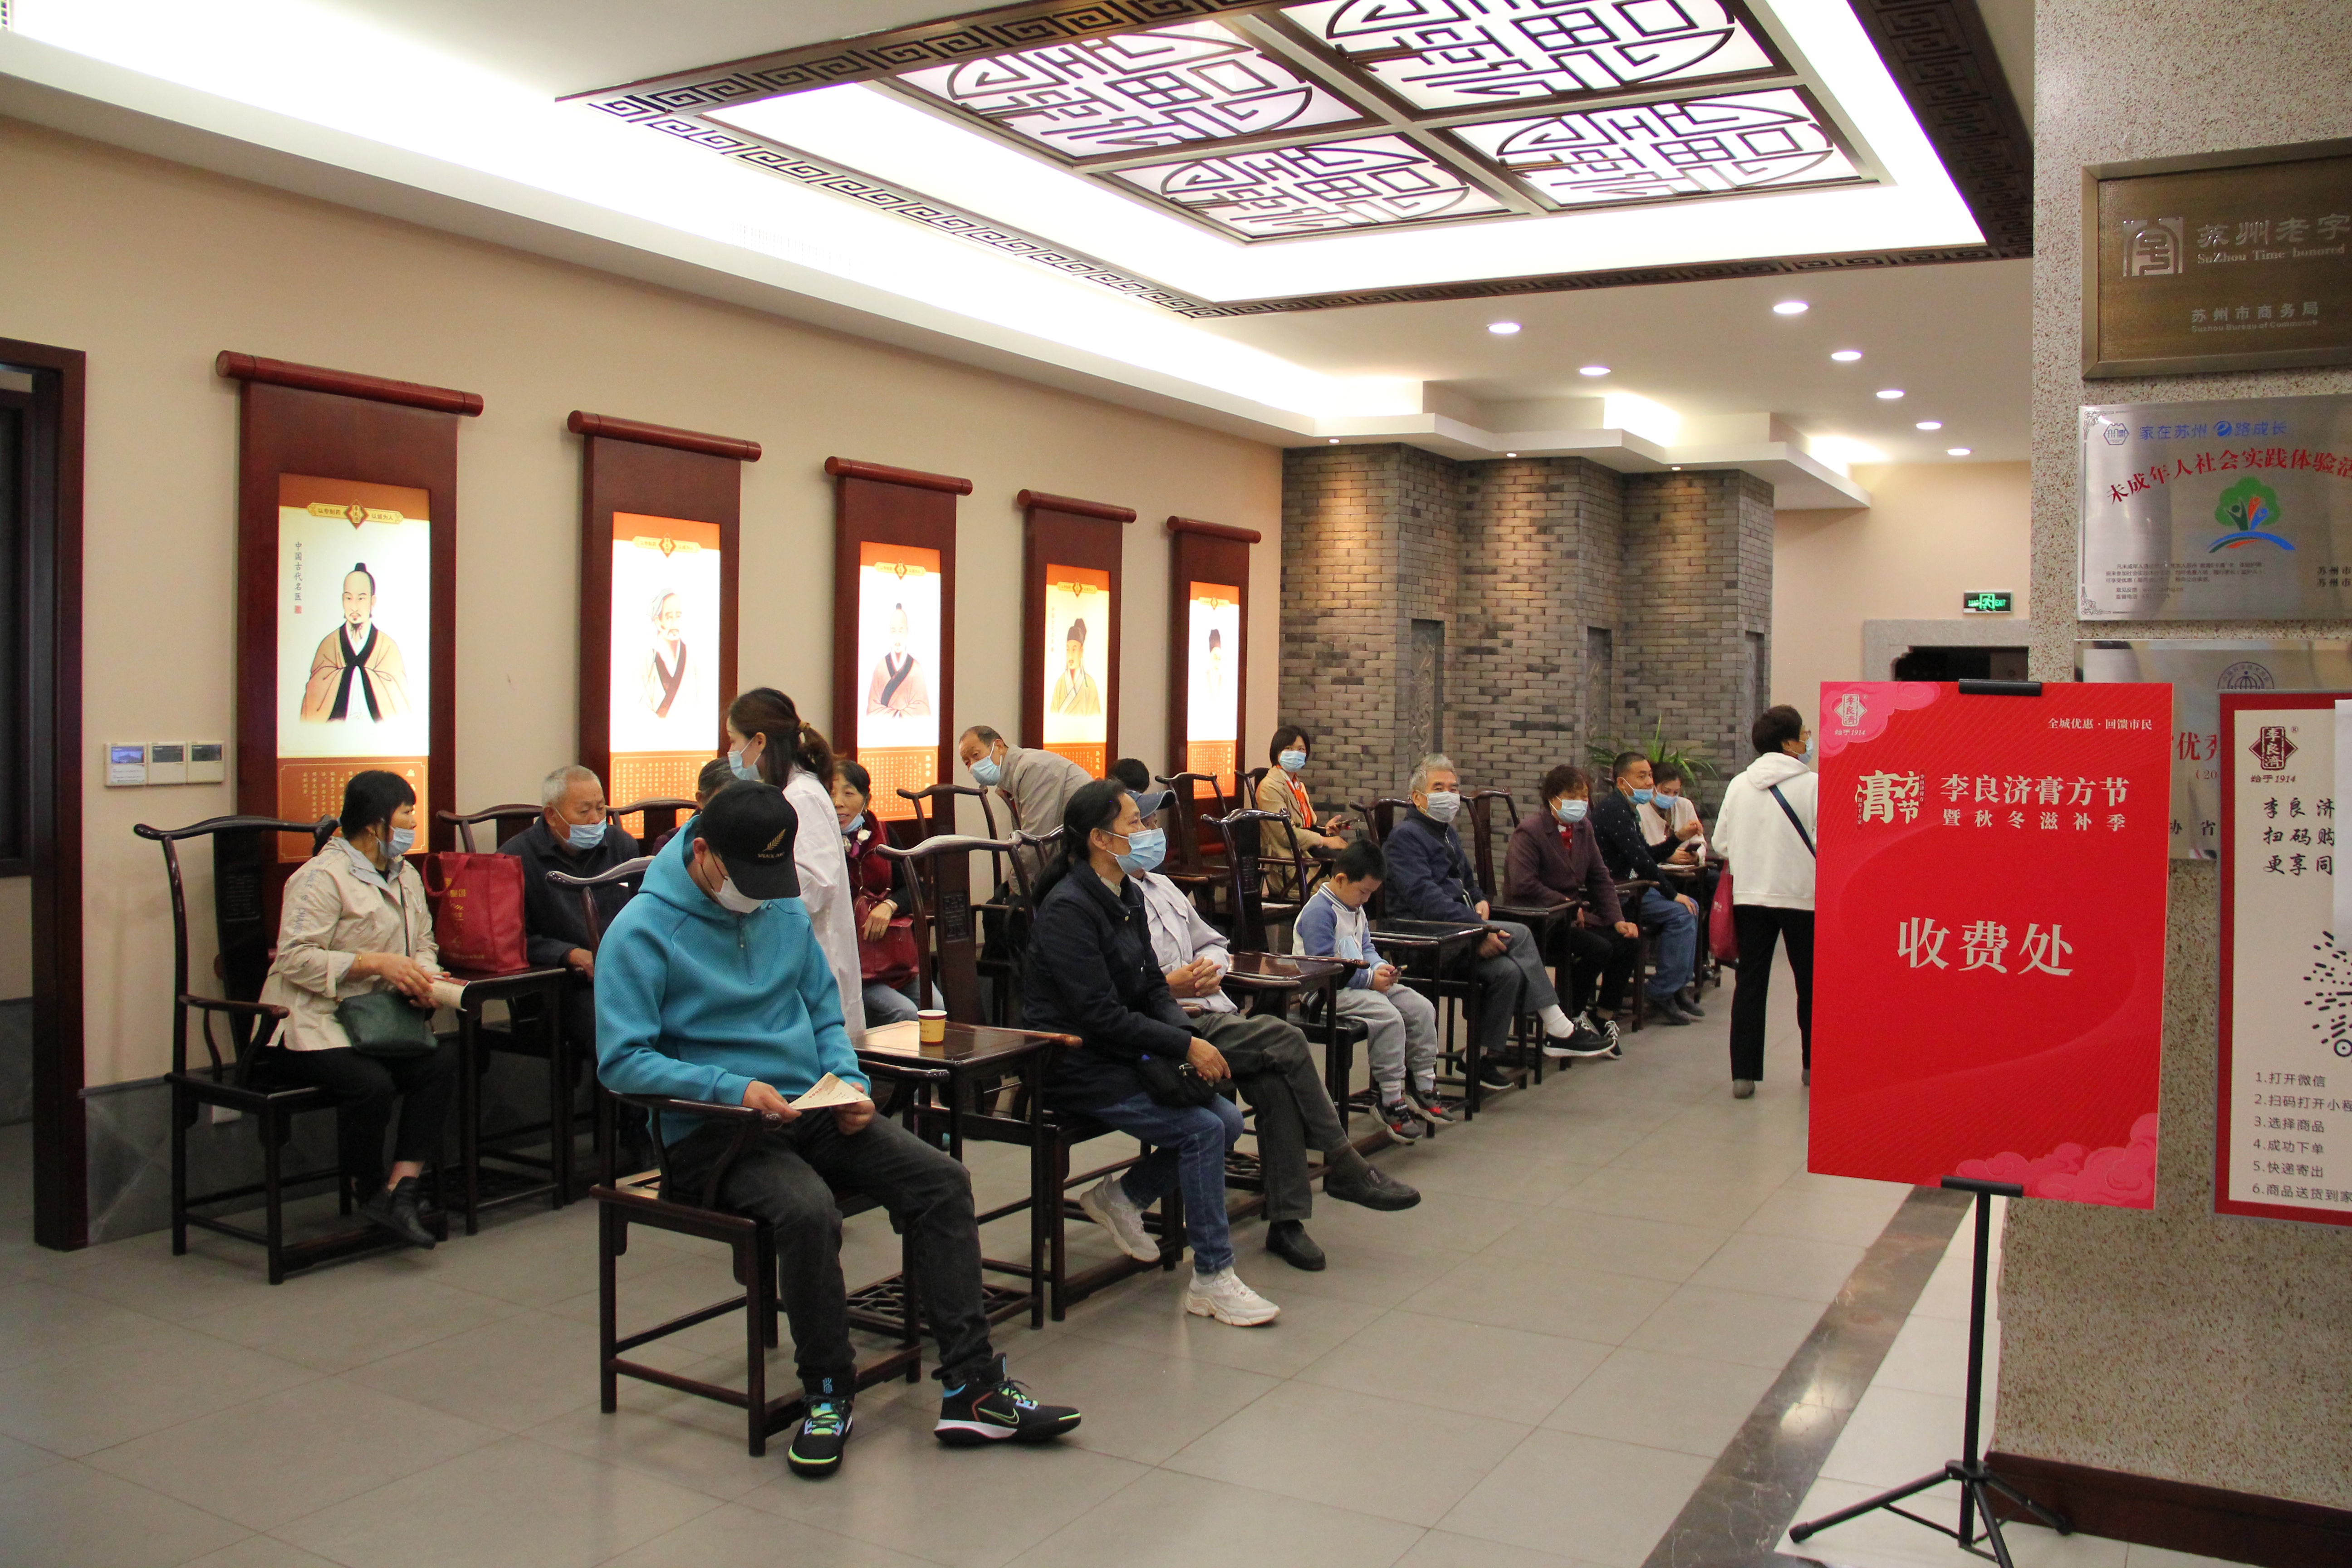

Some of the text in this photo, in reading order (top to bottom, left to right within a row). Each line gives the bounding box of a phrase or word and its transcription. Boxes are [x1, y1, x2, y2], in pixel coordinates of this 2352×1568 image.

[2191, 301, 2318, 323] 苏州市商务局
[2139, 424, 2207, 441] 家在苏州
[294, 541, 303, 601] 中国古代名医
[1995, 599, 2006, 607] EXIT
[1940, 774, 2129, 807] 李良济膏方节
[2264, 797, 2335, 819] 李良济
[1943, 808, 2126, 832] 暨秋冬滋补季
[2263, 826, 2334, 846] 扫码购
[2263, 853, 2332, 876] 更享同
[1897, 916, 2073, 976] 收费处
[2256, 1072, 2326, 1088] 1.打开微信
[2254, 1116, 2324, 1132] 3.选择商品
[2253, 1138, 2324, 1155] 4.成功下单
[2253, 1160, 2323, 1178] 5.快递寄出
